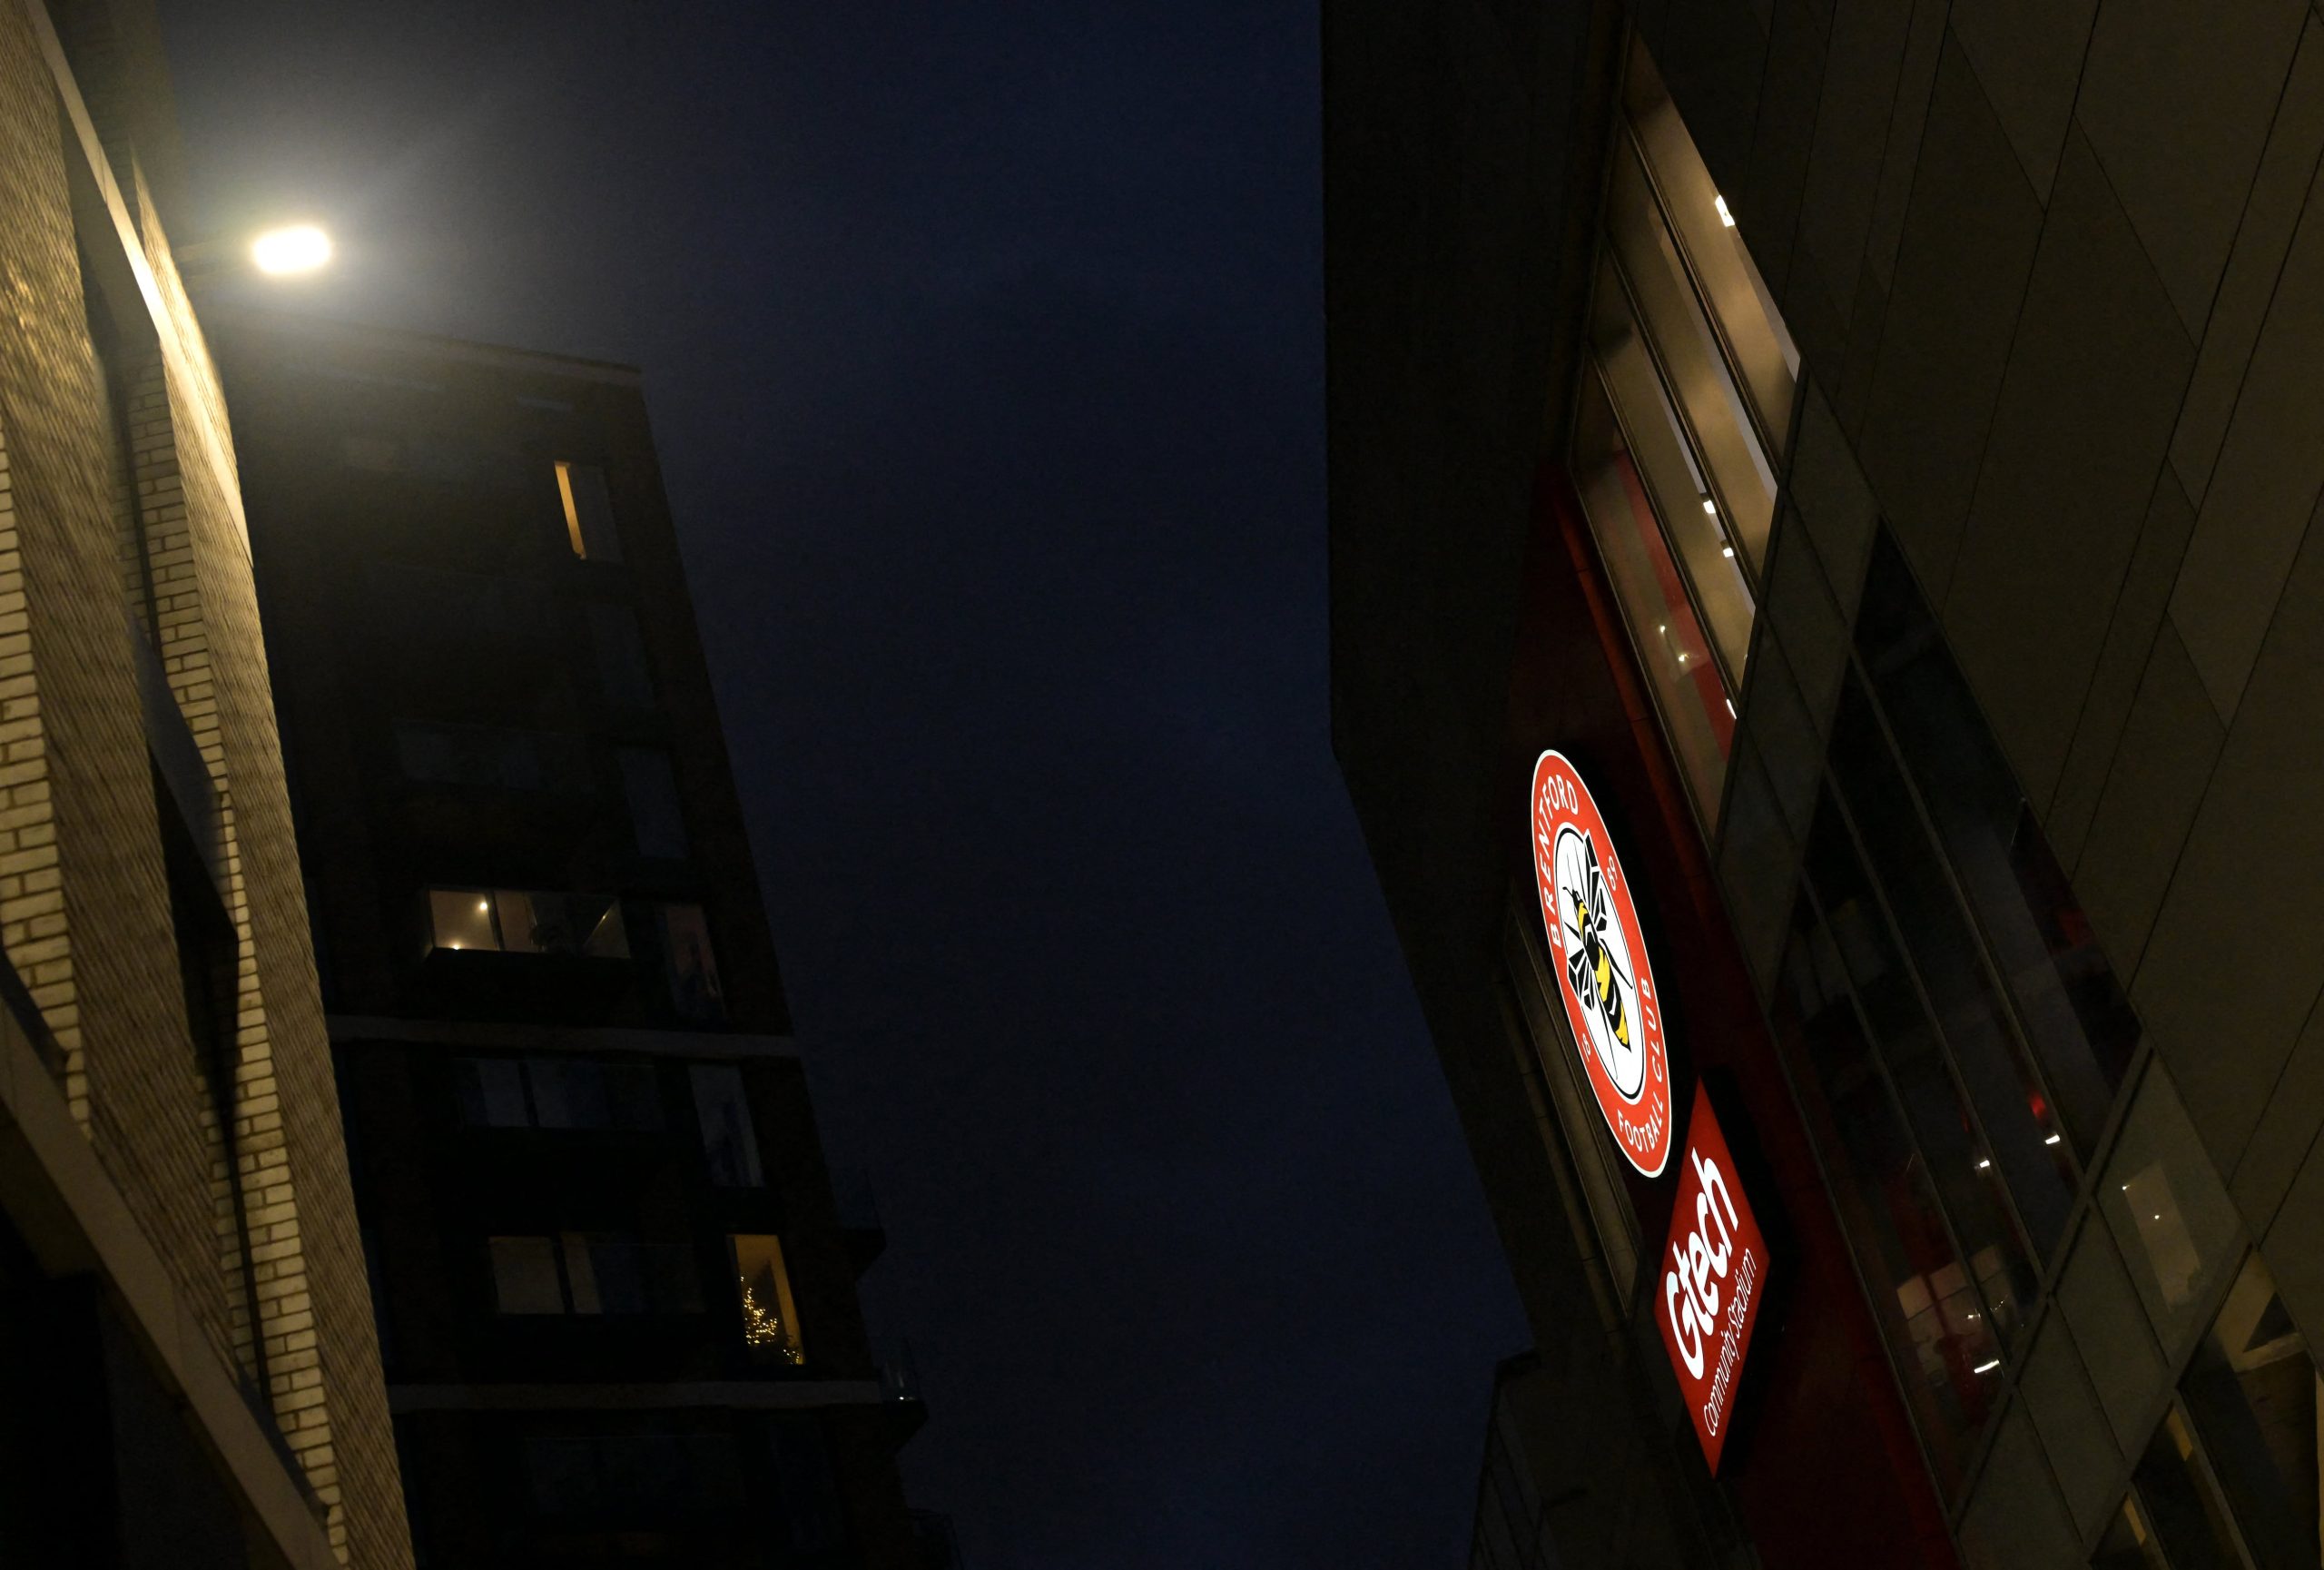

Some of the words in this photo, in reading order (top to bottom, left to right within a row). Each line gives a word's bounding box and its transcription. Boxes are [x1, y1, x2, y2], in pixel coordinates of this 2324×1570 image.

[1538, 774, 1579, 949] BRENTFORD
[1606, 855, 1618, 892] 89
[1581, 1032, 1591, 1062] 18
[1640, 977, 1663, 1083] CLUB
[1617, 1091, 1664, 1153] FOOTBALL
[1667, 1147, 1739, 1380] Gtech
[1703, 1322, 1740, 1437] Community
[1727, 1248, 1756, 1339] Stadium
